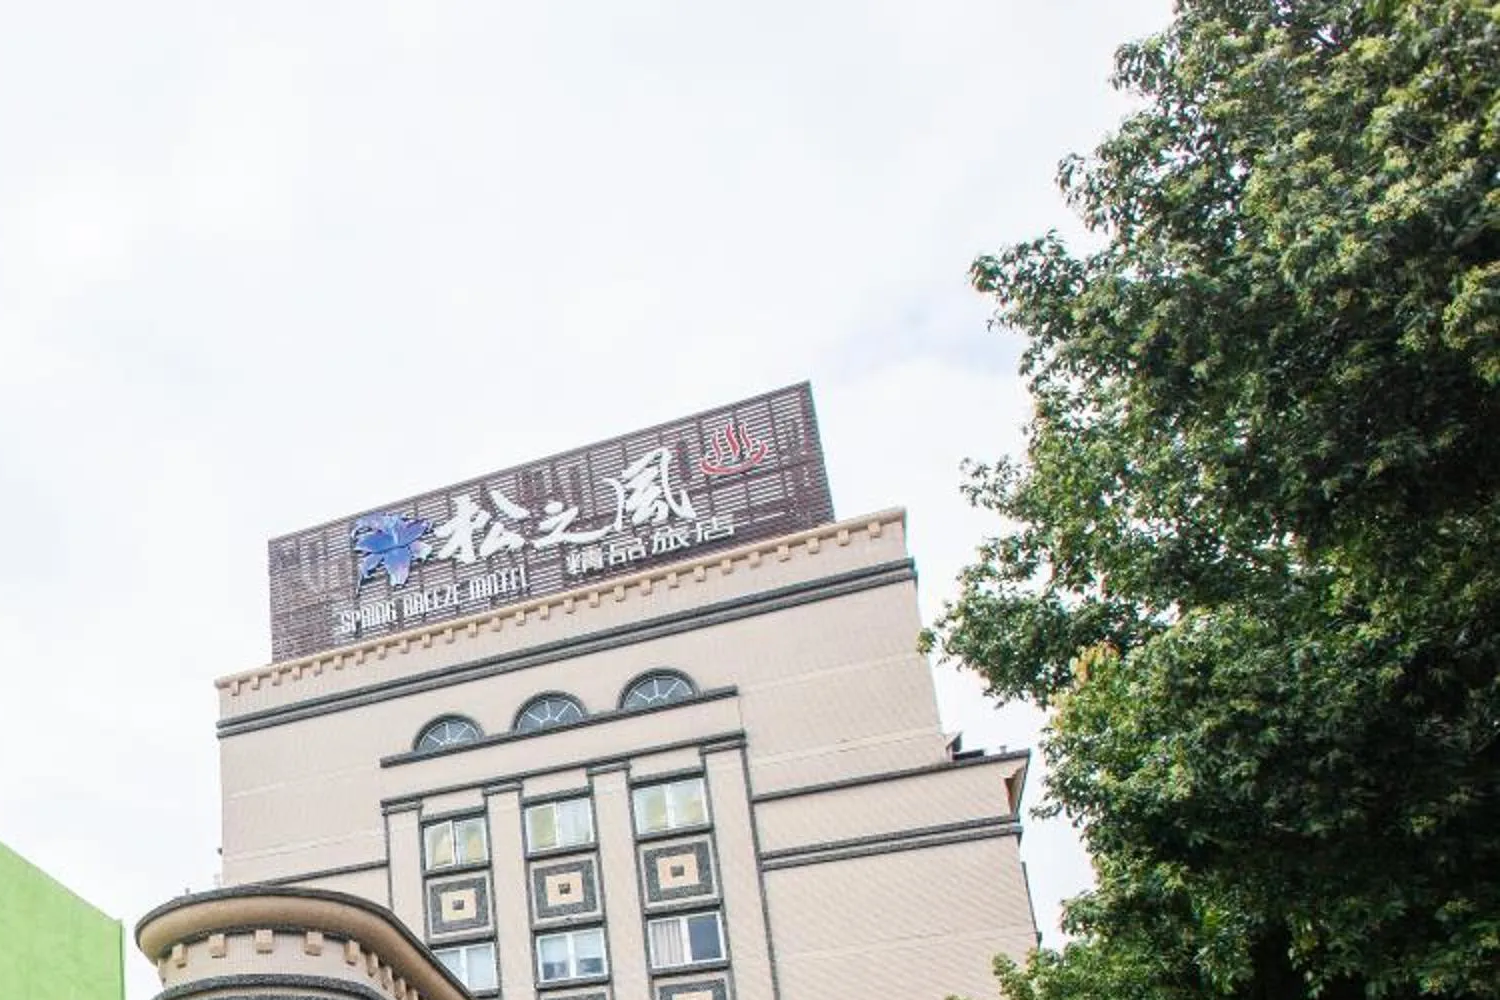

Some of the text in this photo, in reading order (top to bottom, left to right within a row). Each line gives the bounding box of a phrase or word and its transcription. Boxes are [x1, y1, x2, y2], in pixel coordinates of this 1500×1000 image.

[434, 447, 697, 564] 松之風
[566, 516, 736, 575] 精品旅店
[339, 601, 398, 633] SPRING
